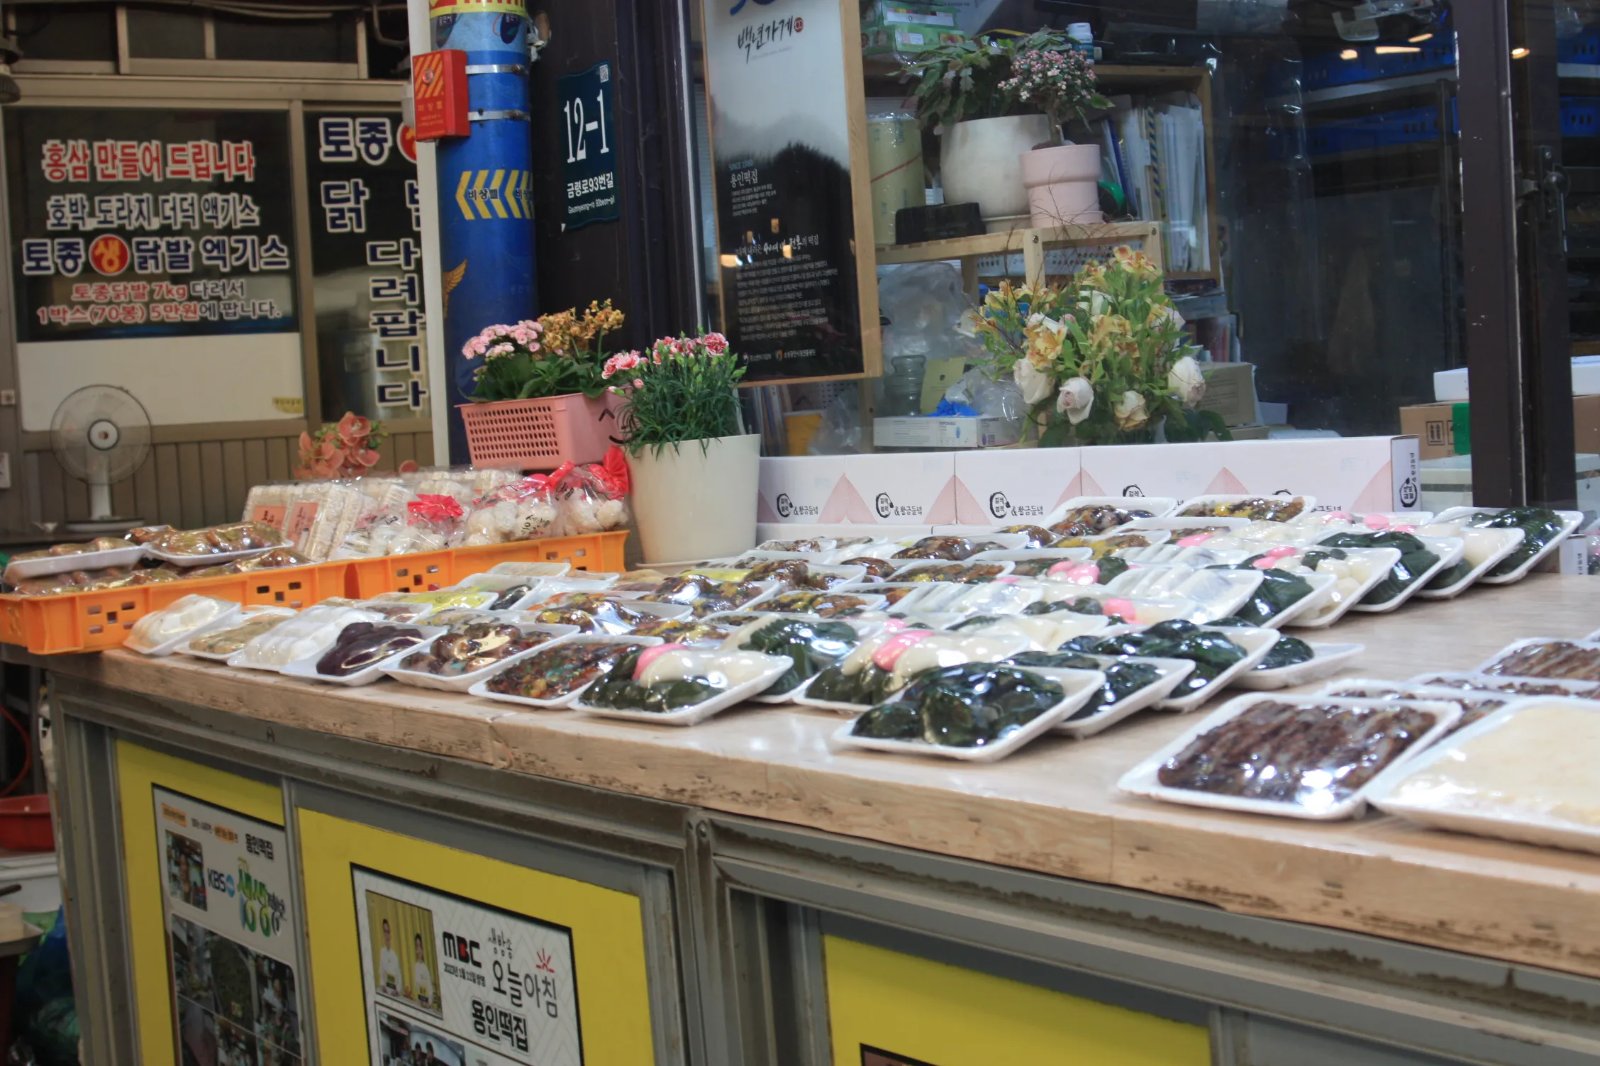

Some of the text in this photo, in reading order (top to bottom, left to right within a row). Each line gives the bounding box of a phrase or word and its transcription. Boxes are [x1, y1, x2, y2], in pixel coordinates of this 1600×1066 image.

[737, 16, 794, 64] 백년가게
[319, 117, 392, 165] 토종
[564, 89, 609, 163] 12-1
[42, 139, 255, 182] 홍삼 만들어 드립니다
[730, 169, 758, 188] 용인떡집
[567, 171, 614, 199] 금령로93번길
[159, 193, 199, 230] 더덕
[22, 238, 86, 277] 토종
[90, 234, 130, 275] 생
[132, 236, 194, 273] 닭발
[71, 280, 245, 302] 토종닭발 7kg 다려서
[37, 303, 146, 324] 1박스(70봉)
[150, 301, 217, 322] 5만원에
[207, 867, 227, 894] KBS
[442, 931, 482, 968] MBC
[471, 998, 529, 1053] 용인떡집
